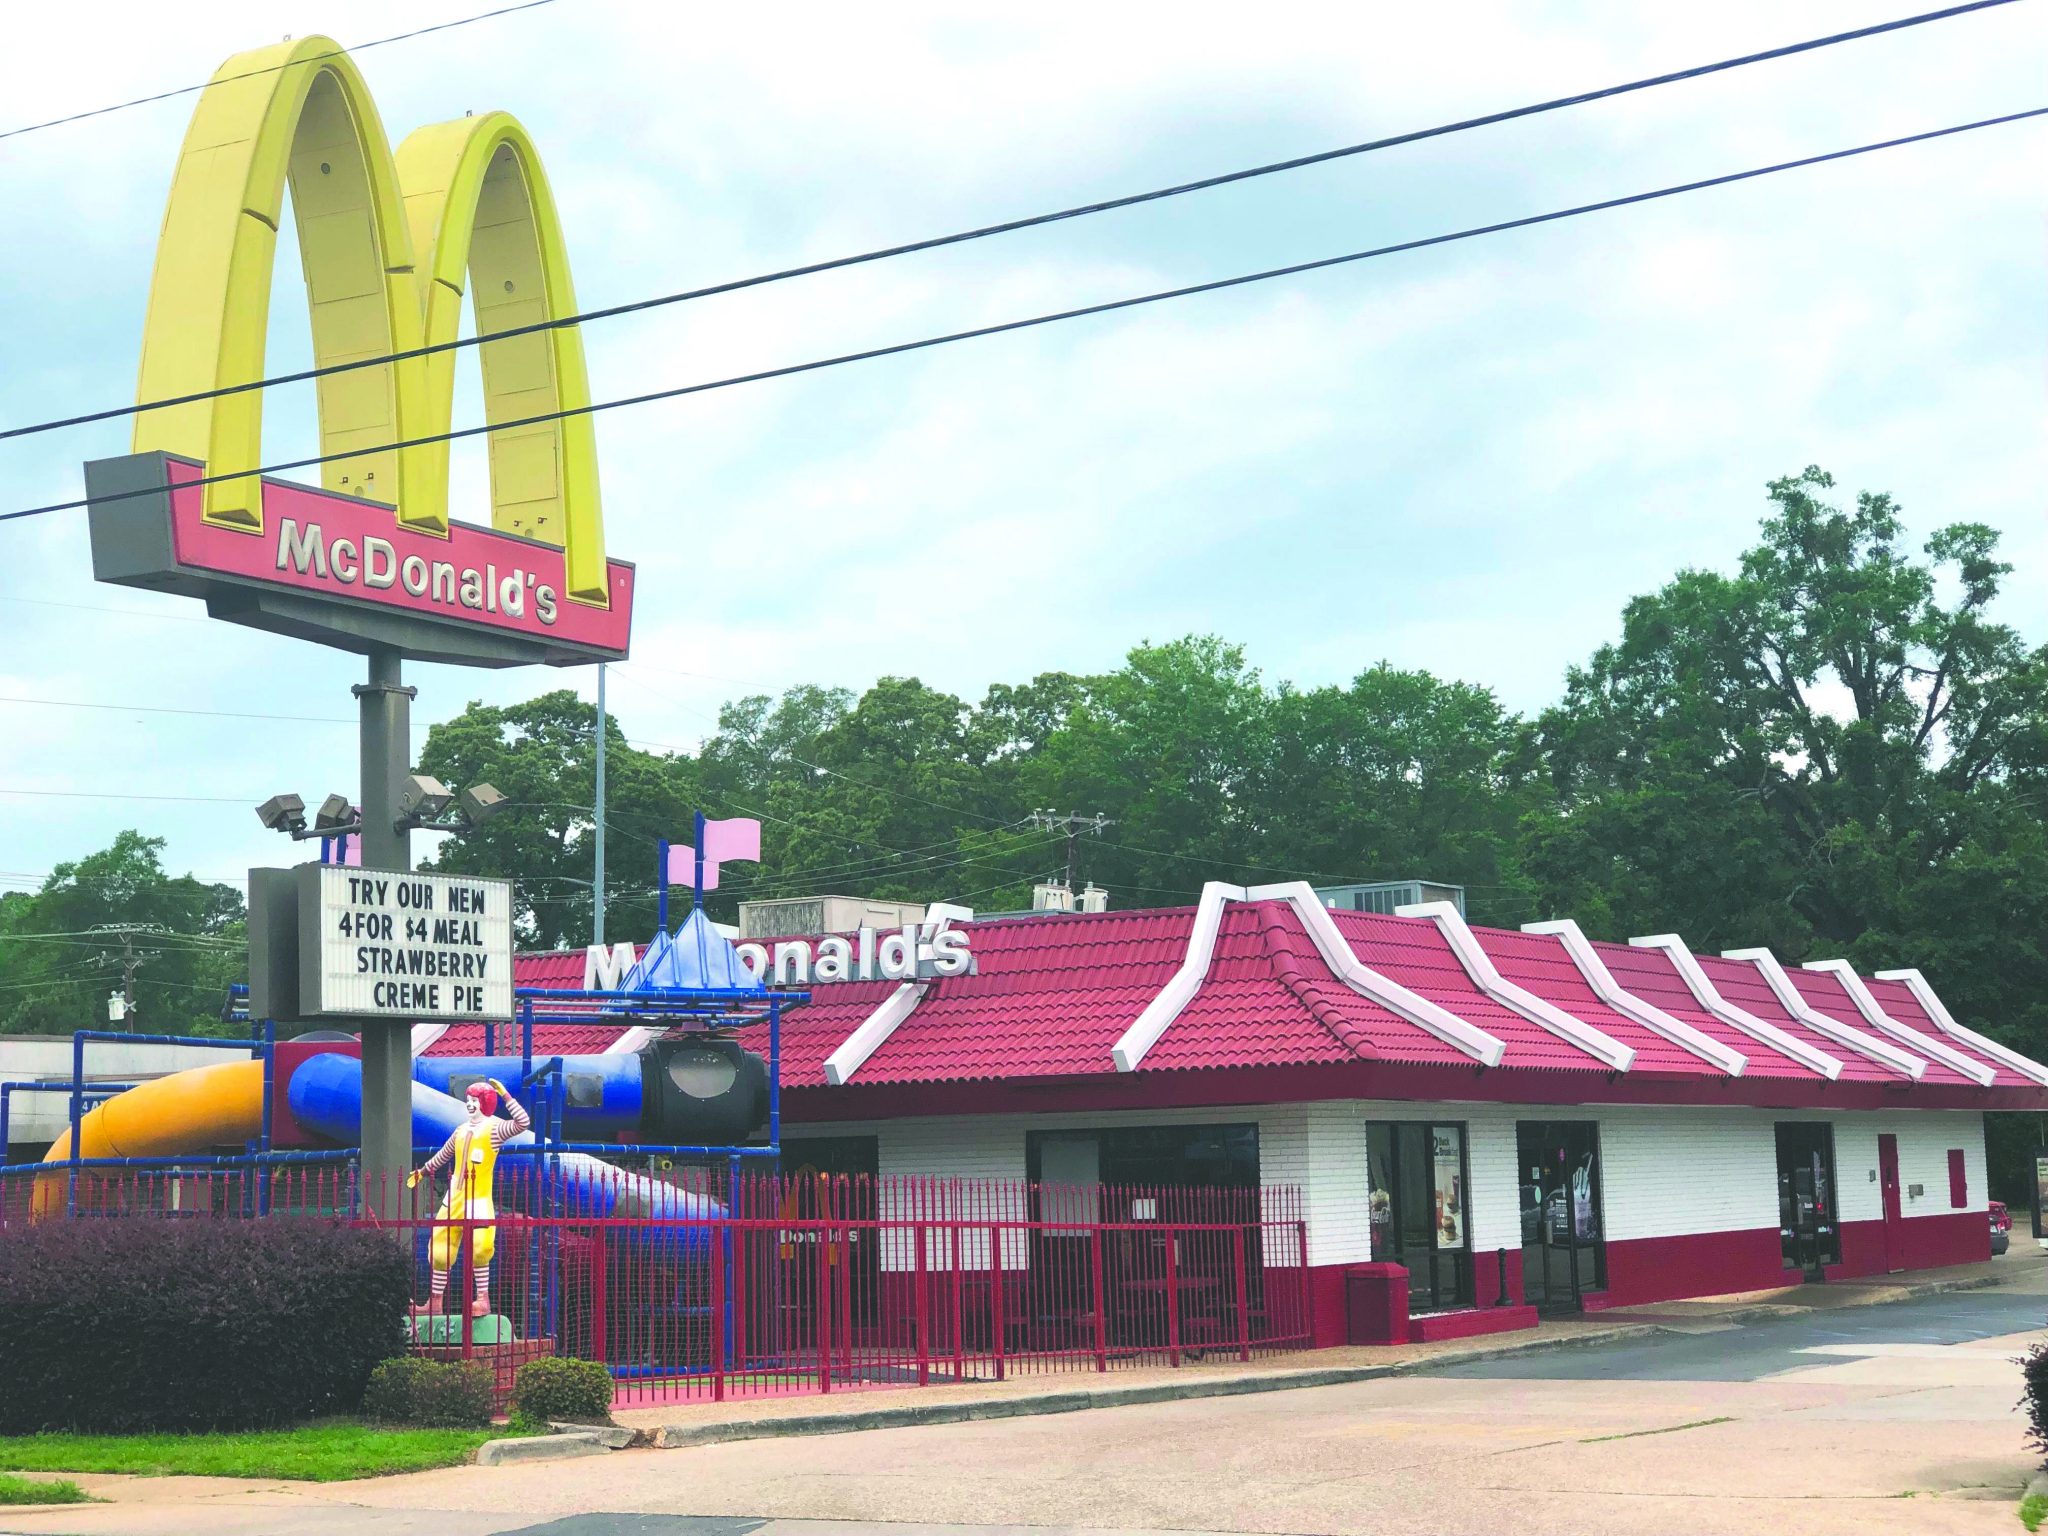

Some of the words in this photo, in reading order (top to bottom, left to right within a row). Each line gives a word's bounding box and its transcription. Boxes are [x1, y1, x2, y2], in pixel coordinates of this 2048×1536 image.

[275, 517, 558, 625] McDonald's
[348, 877, 389, 906] TRY
[397, 881, 433, 910] OUR
[448, 886, 485, 915] NEW
[406, 916, 428, 943] $4
[432, 919, 483, 946] MEAL
[357, 946, 488, 979] STRAWBERRY
[373, 981, 439, 1010] CREME
[453, 985, 483, 1012] PIE
